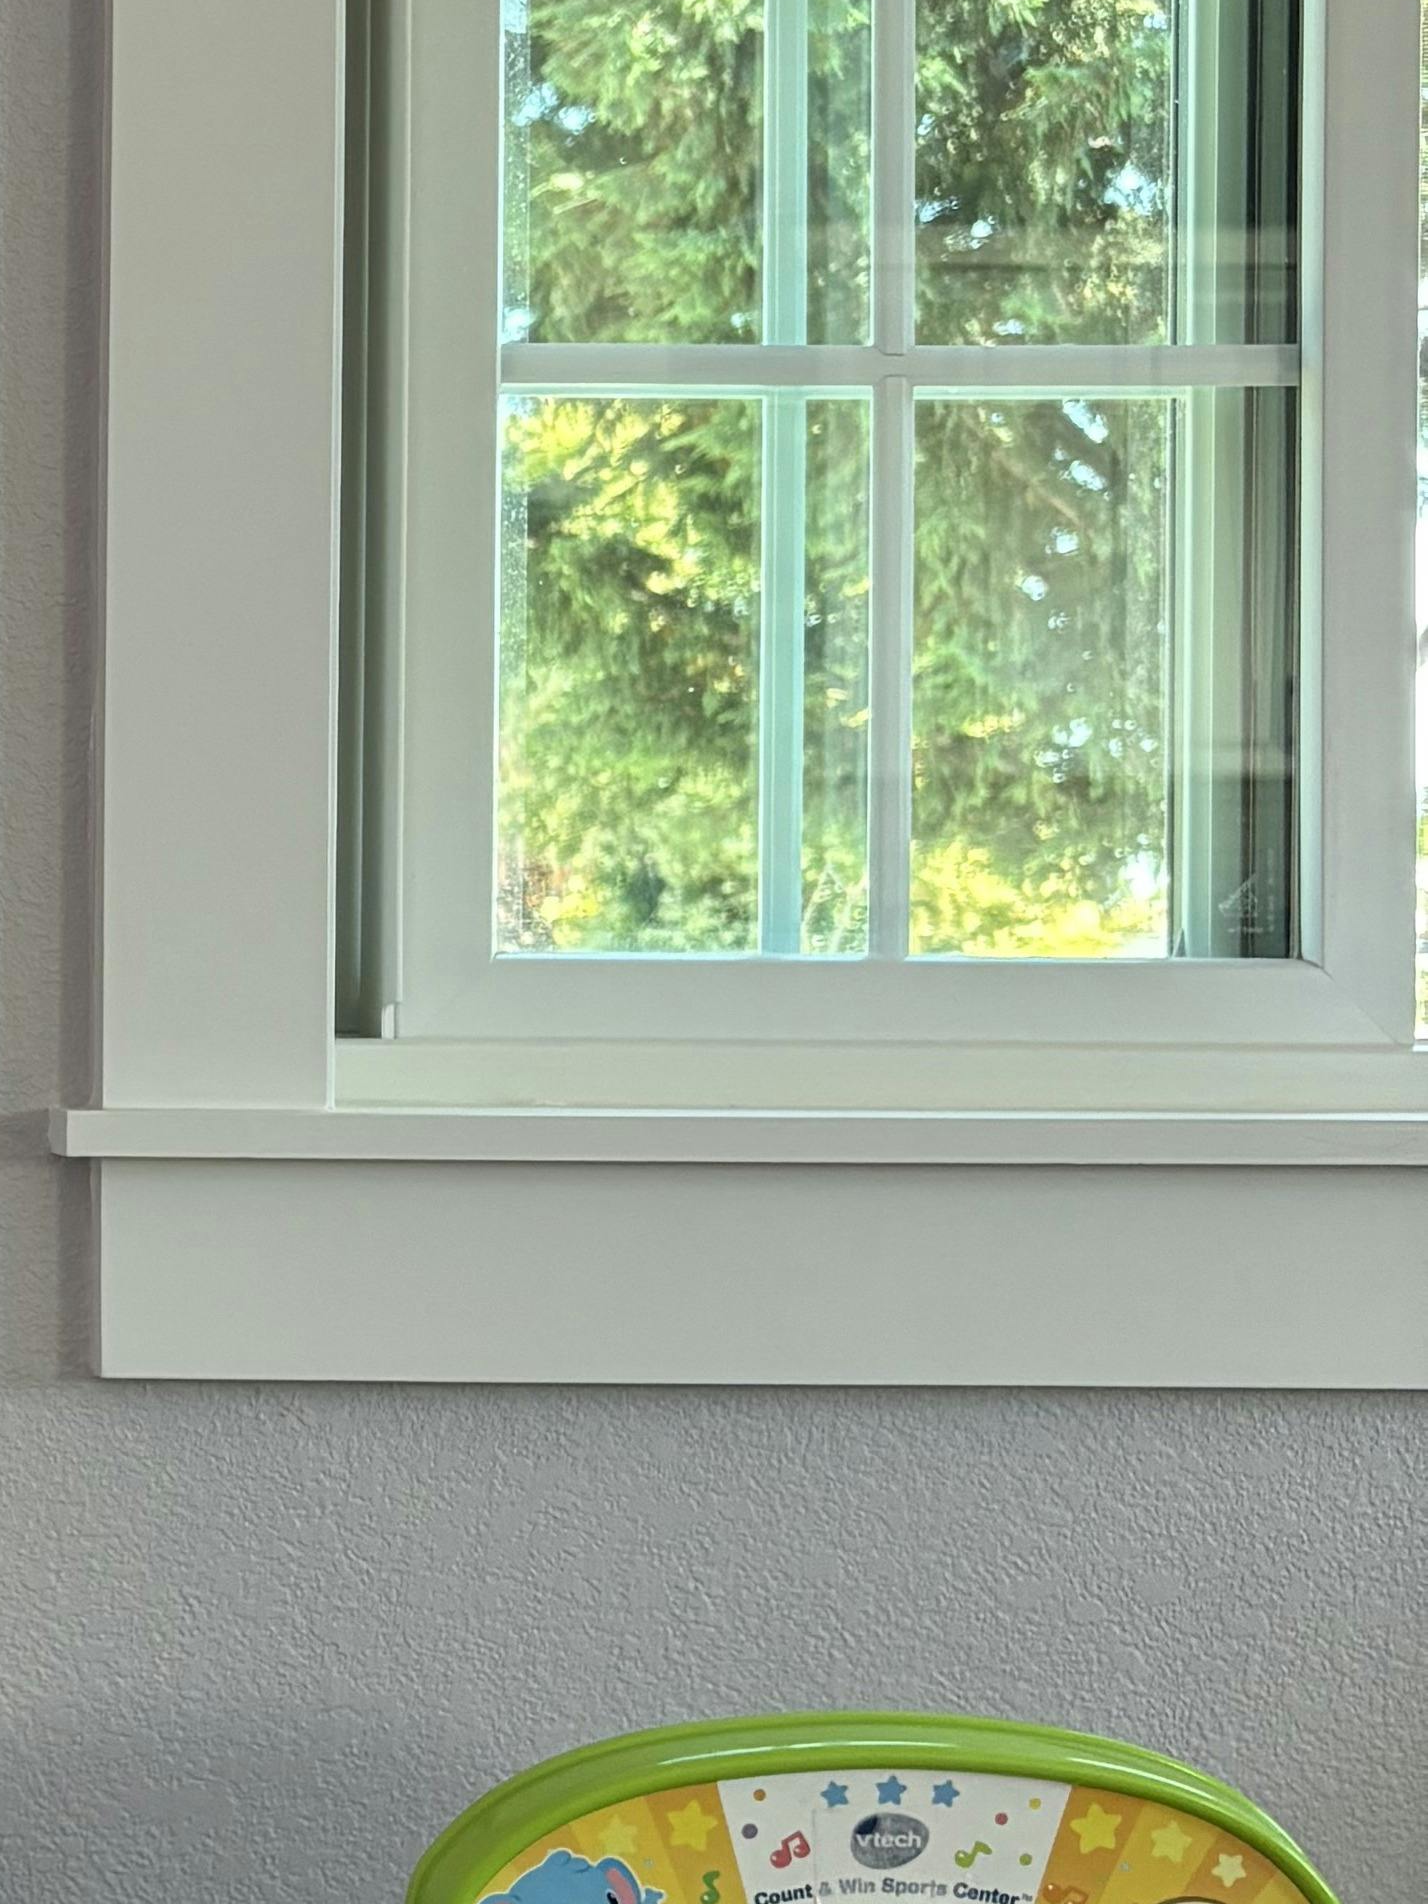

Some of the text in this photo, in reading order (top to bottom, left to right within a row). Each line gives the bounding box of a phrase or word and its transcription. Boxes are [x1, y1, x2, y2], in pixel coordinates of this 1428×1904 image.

[854, 1830, 923, 1850] vtech
[837, 1877, 877, 1896] Win
[880, 1876, 948, 1898] Sports
